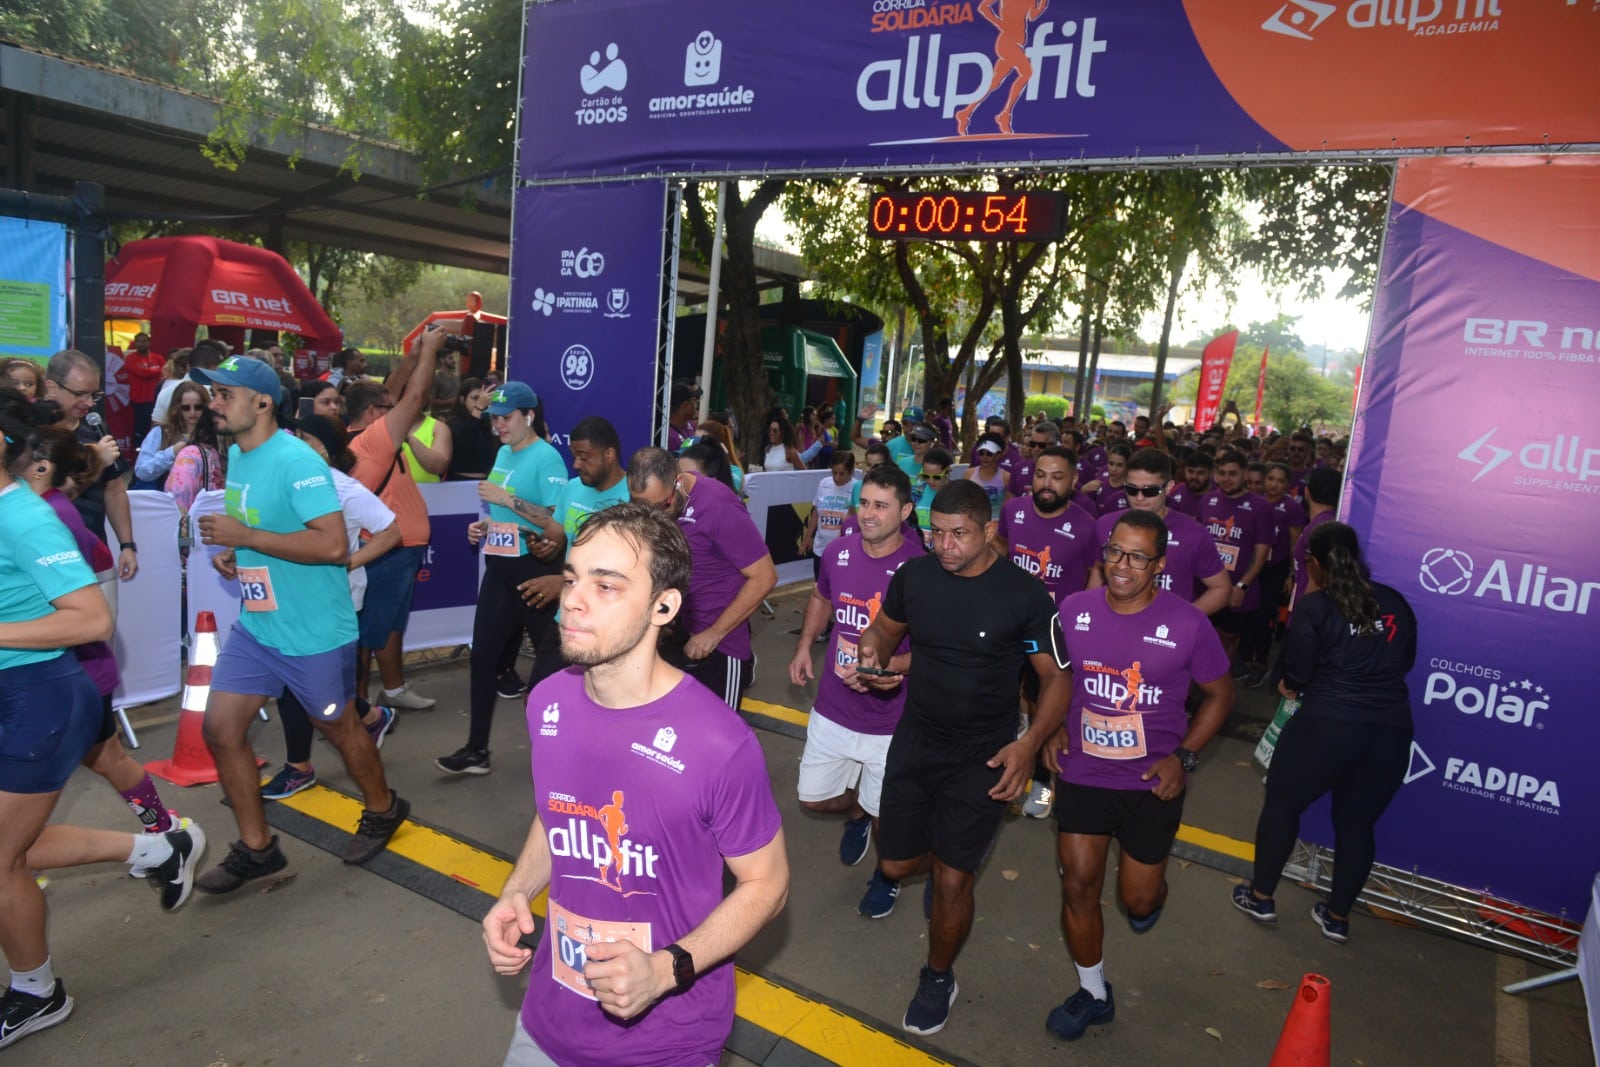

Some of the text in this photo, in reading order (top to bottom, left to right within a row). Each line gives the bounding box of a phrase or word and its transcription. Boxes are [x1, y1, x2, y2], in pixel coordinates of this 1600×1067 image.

[871, 1, 974, 33] SOLIDÁRIA
[1414, 20, 1500, 37] ACADEMIA
[612, 96, 623, 105] de
[649, 86, 754, 112] amorsaúde
[575, 106, 628, 125] TODOS
[873, 195, 1028, 234] 0:00:54
[561, 250, 575, 259] IPA
[561, 259, 574, 268] TIN
[560, 267, 573, 276] GA
[127, 282, 157, 299] net
[211, 289, 250, 307] BR
[252, 296, 293, 315] net
[556, 297, 599, 309] IPATINGA
[1464, 318, 1600, 351] BR n
[1464, 346, 1595, 363] INTERNET 100% FIBRA
[566, 355, 589, 377] 98
[1045, 563, 1064, 578] fit
[1138, 684, 1163, 705] fit
[1423, 672, 1549, 728] Polar
[1085, 726, 1135, 748] 0518
[1444, 757, 1561, 808] FADIPA
[1442, 781, 1560, 816] FACULDADE DE IPATINGA
[548, 818, 659, 879] allp fit
